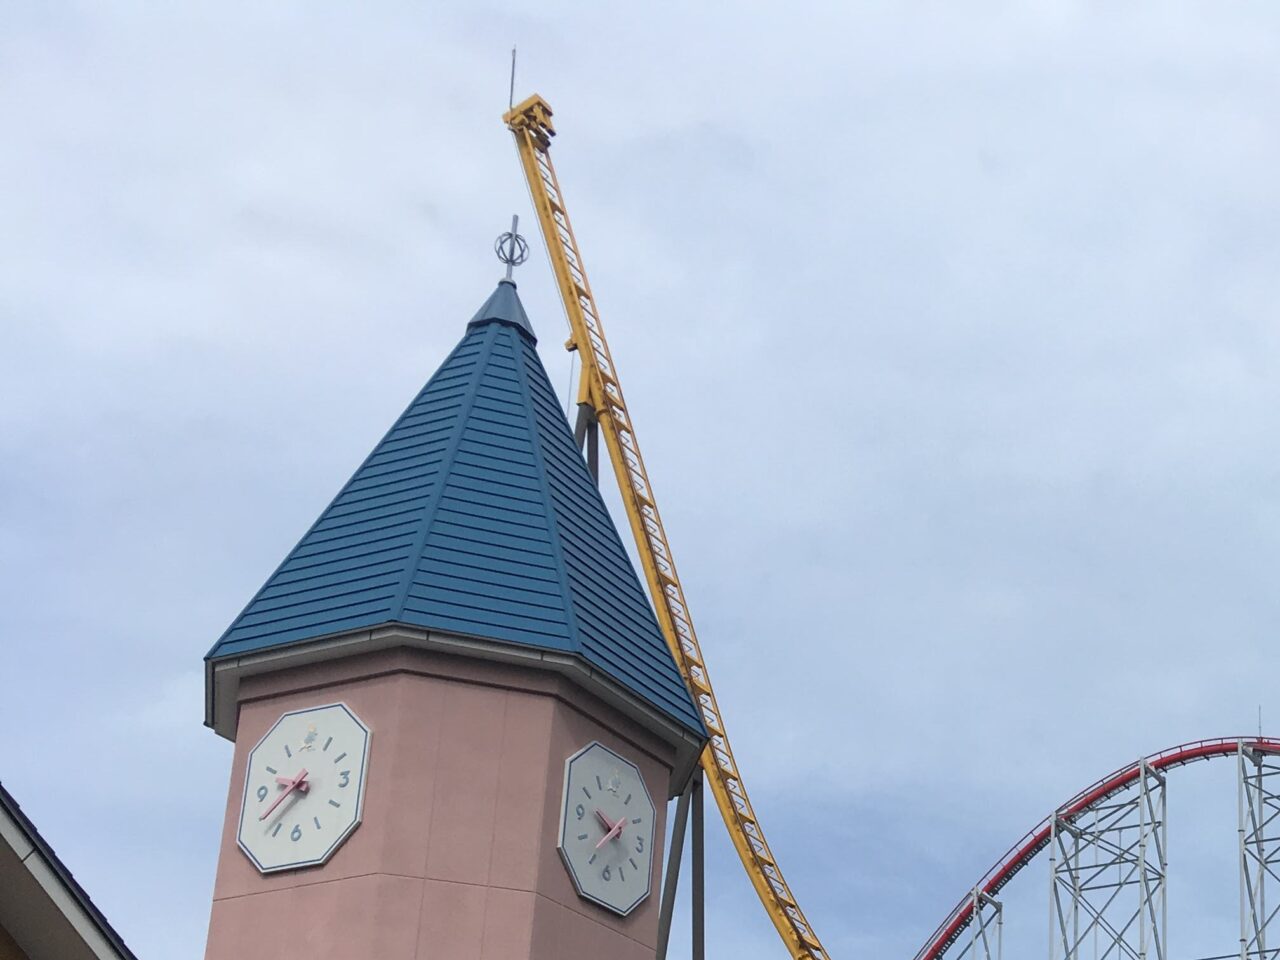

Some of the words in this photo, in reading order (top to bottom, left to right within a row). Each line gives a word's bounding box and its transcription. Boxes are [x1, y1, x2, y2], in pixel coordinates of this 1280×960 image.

[338, 769, 351, 788] 3
[256, 785, 269, 803] 9
[575, 803, 586, 821] 9
[290, 824, 302, 842] 6
[635, 835, 645, 854] 3
[602, 864, 612, 882] 6
